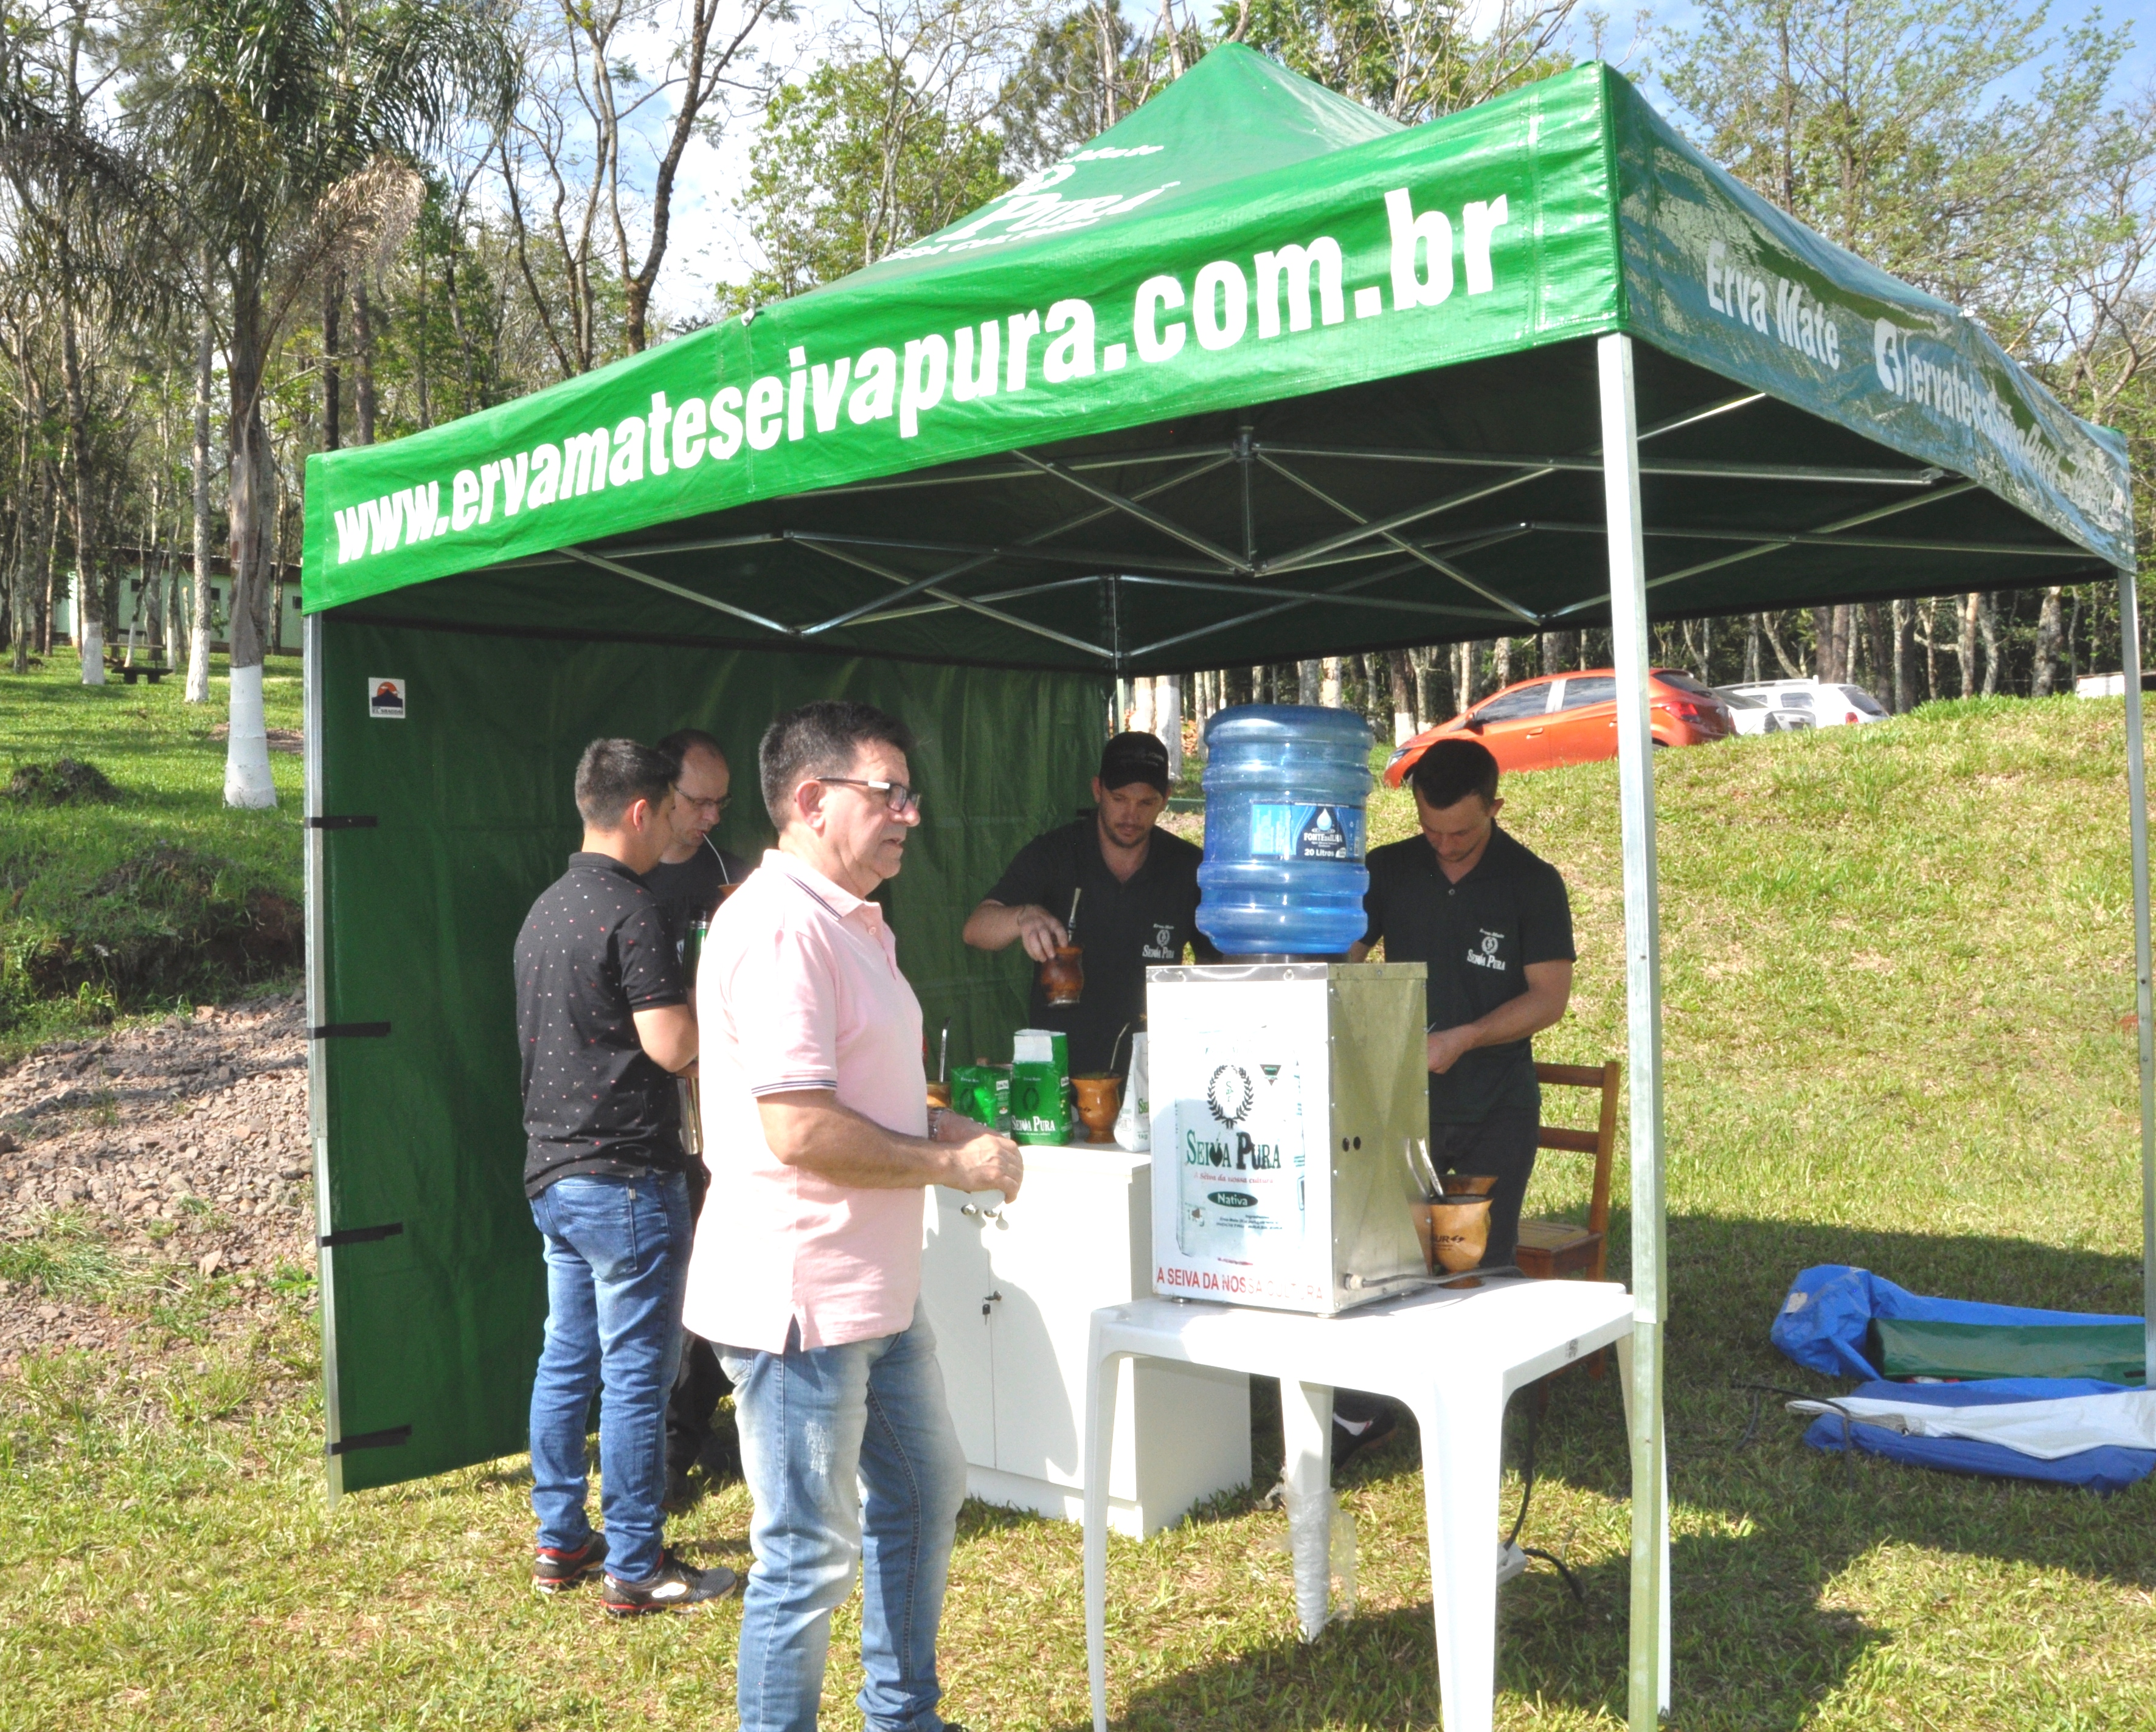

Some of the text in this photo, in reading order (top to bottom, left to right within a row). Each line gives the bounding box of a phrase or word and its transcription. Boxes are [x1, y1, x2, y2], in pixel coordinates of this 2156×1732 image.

[1707, 238, 1769, 336] Erva
[1776, 278, 1840, 370] Mate
[334, 187, 1508, 564] www.ervamateseivapura.com.br
[1486, 955, 1506, 971] PURA
[1011, 1115, 1056, 1131] SEIVA PURA
[1187, 1129, 1281, 1171] SEIVA PURA
[1218, 1193, 1248, 1206] Nativa
[1157, 1267, 1165, 1284] A
[1168, 1268, 1200, 1288] SEIVA
[1203, 1272, 1219, 1290] DA
[1222, 1275, 1263, 1294] NOSSA
